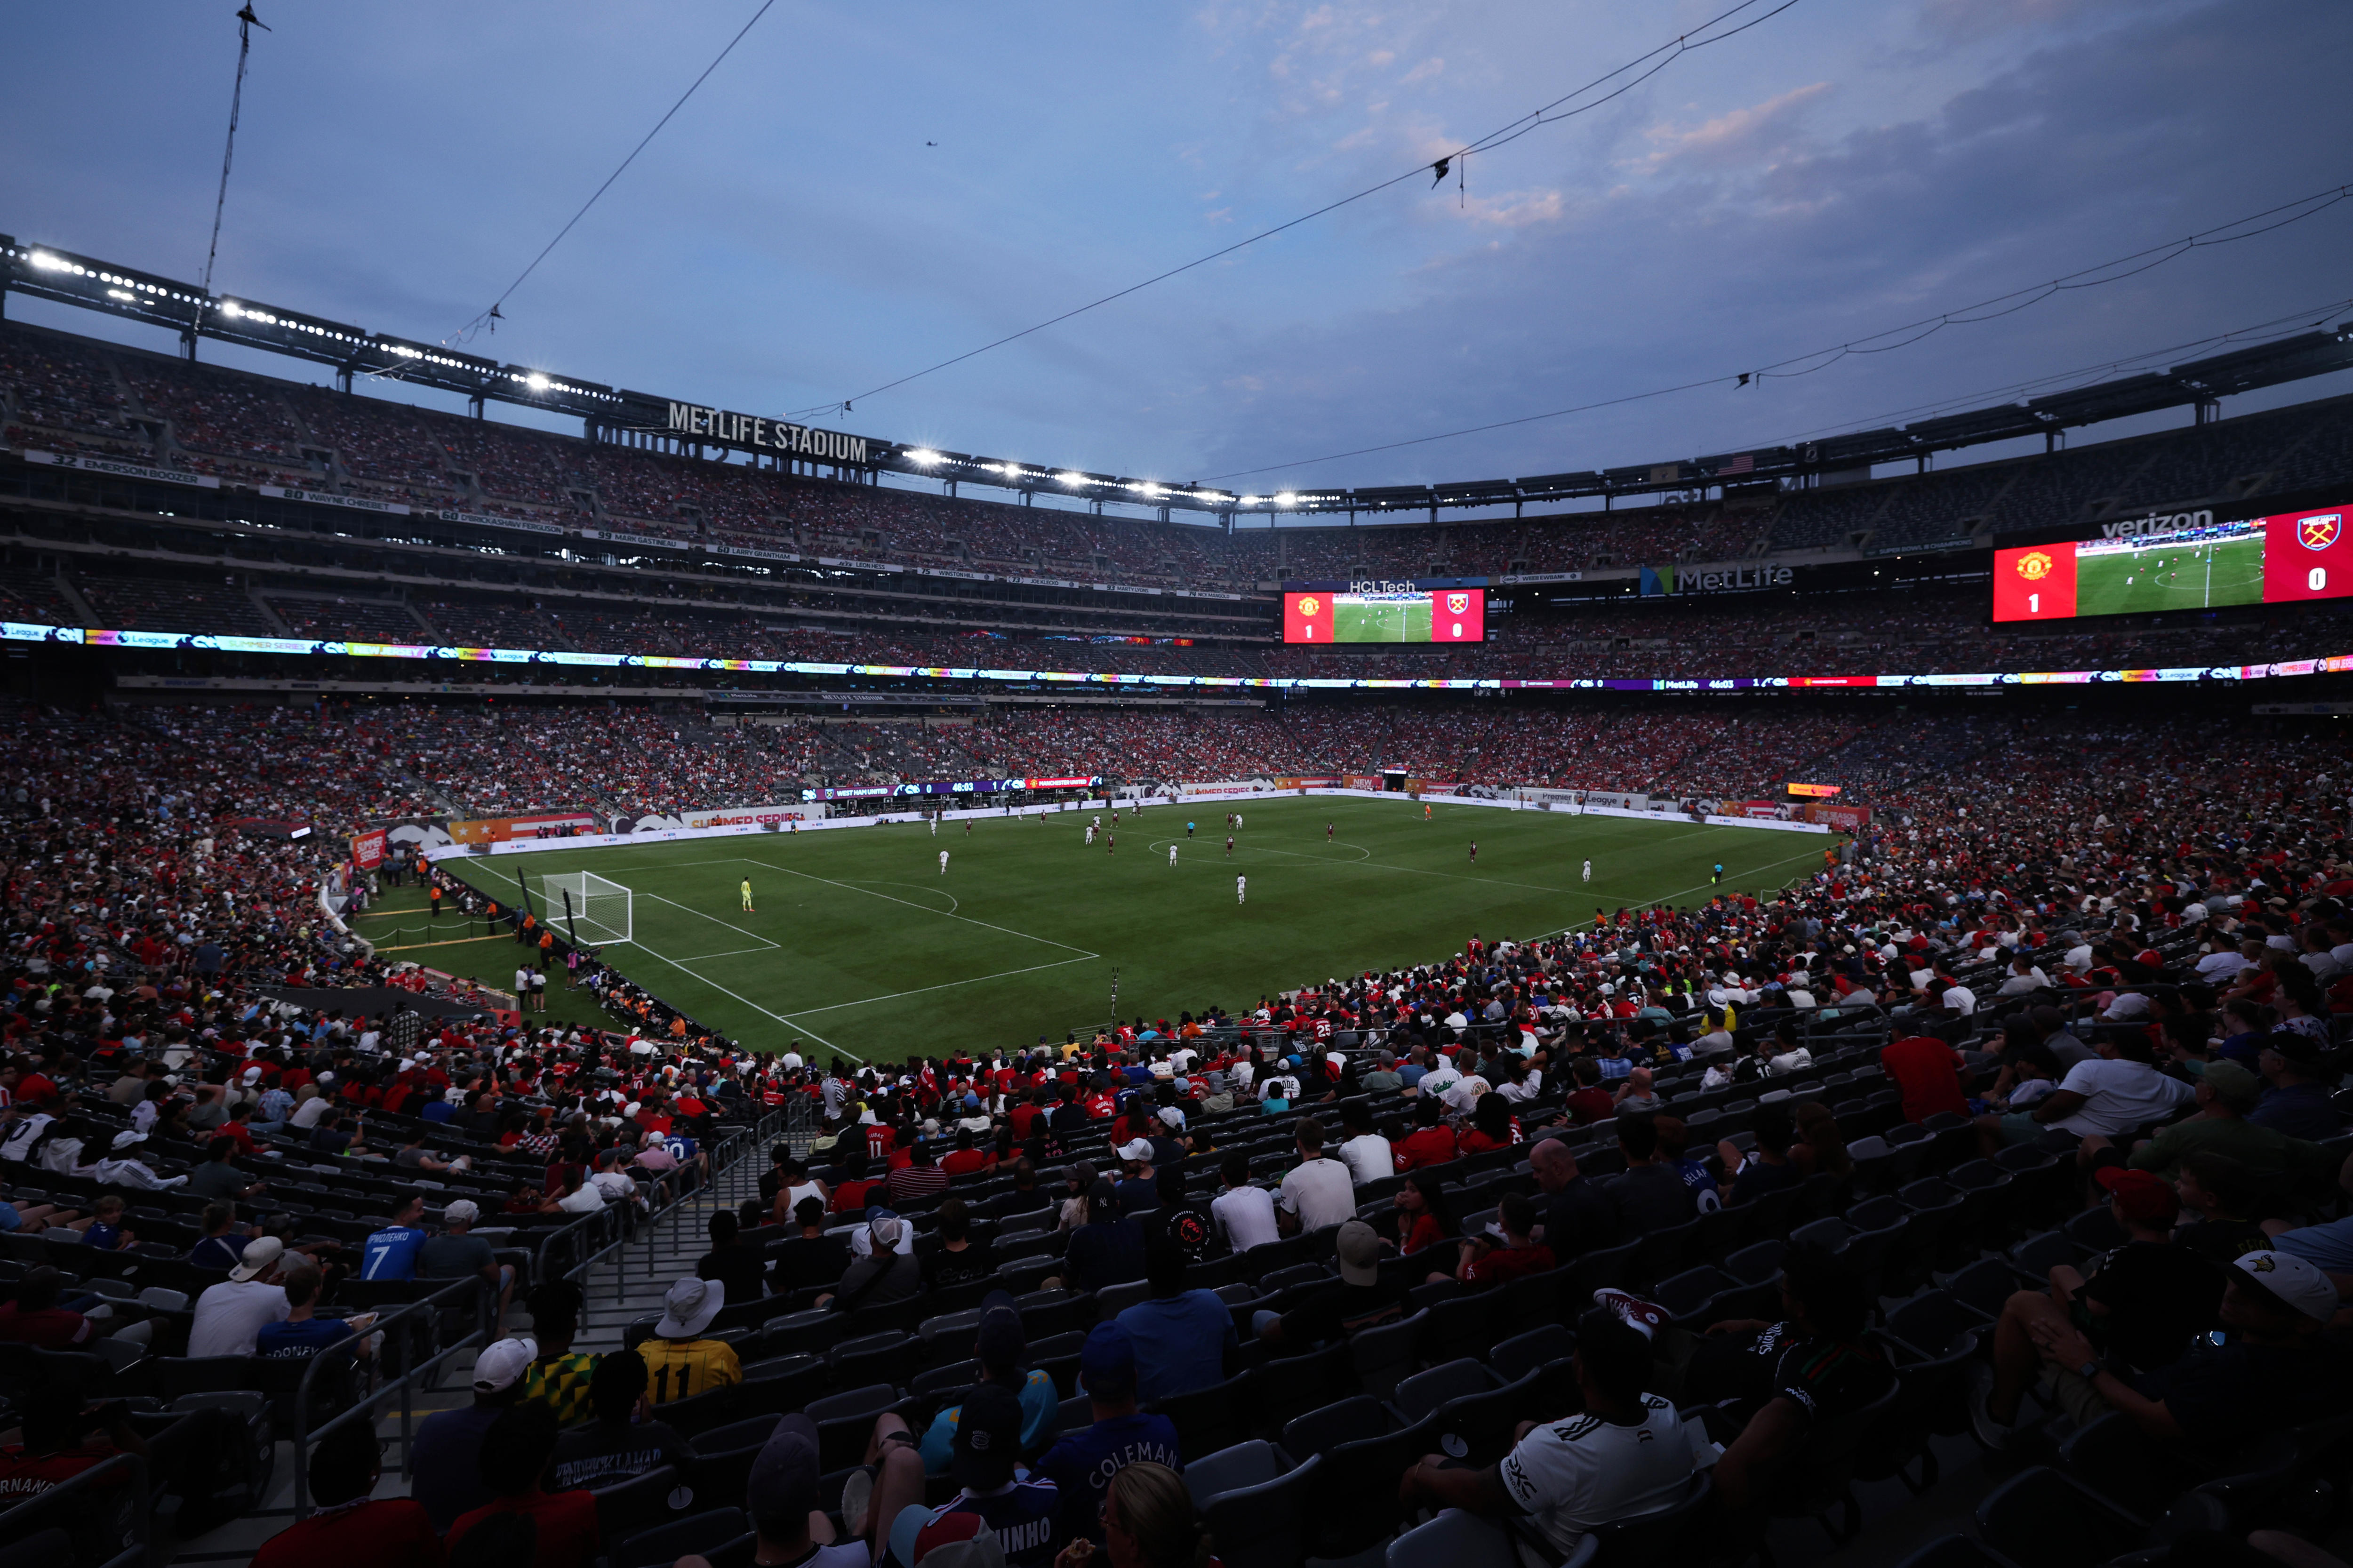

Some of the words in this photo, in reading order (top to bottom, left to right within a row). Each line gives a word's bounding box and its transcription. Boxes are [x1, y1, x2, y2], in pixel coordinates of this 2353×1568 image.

[669, 401, 767, 446] METLIFE
[775, 423, 866, 463] STADIUM
[52, 455, 77, 467] 32
[85, 460, 147, 476] EMERSON
[149, 469, 198, 484] BOOZER
[283, 489, 304, 499] 80
[308, 493, 344, 505] WAYNE
[349, 499, 390, 511] CHREBET
[442, 511, 459, 520] 60
[522, 522, 562, 533] FERGUSON
[2101, 510, 2214, 538] verizon
[598, 532, 612, 540] 99
[615, 534, 637, 542] MARK
[638, 537, 676, 547] GASTINEAU
[1901, 545, 1922, 553] BOWL
[1930, 539, 1973, 549] CHAMPIONS
[717, 546, 730, 554] 60
[754, 551, 791, 560] GRANTHAM
[1678, 562, 1794, 592] MetLife
[2308, 567, 2327, 591] 0
[1350, 580, 1415, 593] HCLTech
[2028, 593, 2039, 613] 1
[12, 627, 40, 637] League
[1305, 624, 1312, 639] 1
[1452, 623, 1463, 637] 0
[132, 637, 169, 645] League
[353, 645, 380, 655] NEW
[379, 647, 423, 656] JERSEY
[1597, 680, 1603, 688] 0
[1666, 680, 1699, 688] MetLife
[1709, 680, 1734, 688] 46:03
[1753, 678, 1760, 687] 1
[867, 788, 888, 796] UNITED
[926, 784, 932, 793] 0
[952, 782, 974, 792] 46:03
[992, 781, 998, 790] 1
[1542, 792, 1572, 801] Premier
[1586, 794, 1617, 805] League
[357, 835, 383, 854] SUMMER
[360, 847, 380, 864] SERIES
[1316, 1024, 1331, 1038] 25
[1095, 1101, 1115, 1110] RONALDO
[1102, 1108, 1112, 1118] 7
[869, 1140, 881, 1160] 11
[1683, 1168, 1708, 1186] DELAP
[1170, 1210, 1194, 1222] ENGINEERED
[369, 1245, 391, 1280] 7
[266, 1346, 320, 1358] OONEY
[654, 1363, 691, 1404] 11
[1088, 1441, 1177, 1489] COLEMAN
[1504, 1461, 1529, 1503] TECHNOLOGY
[1508, 1454, 1538, 1500] DXC
